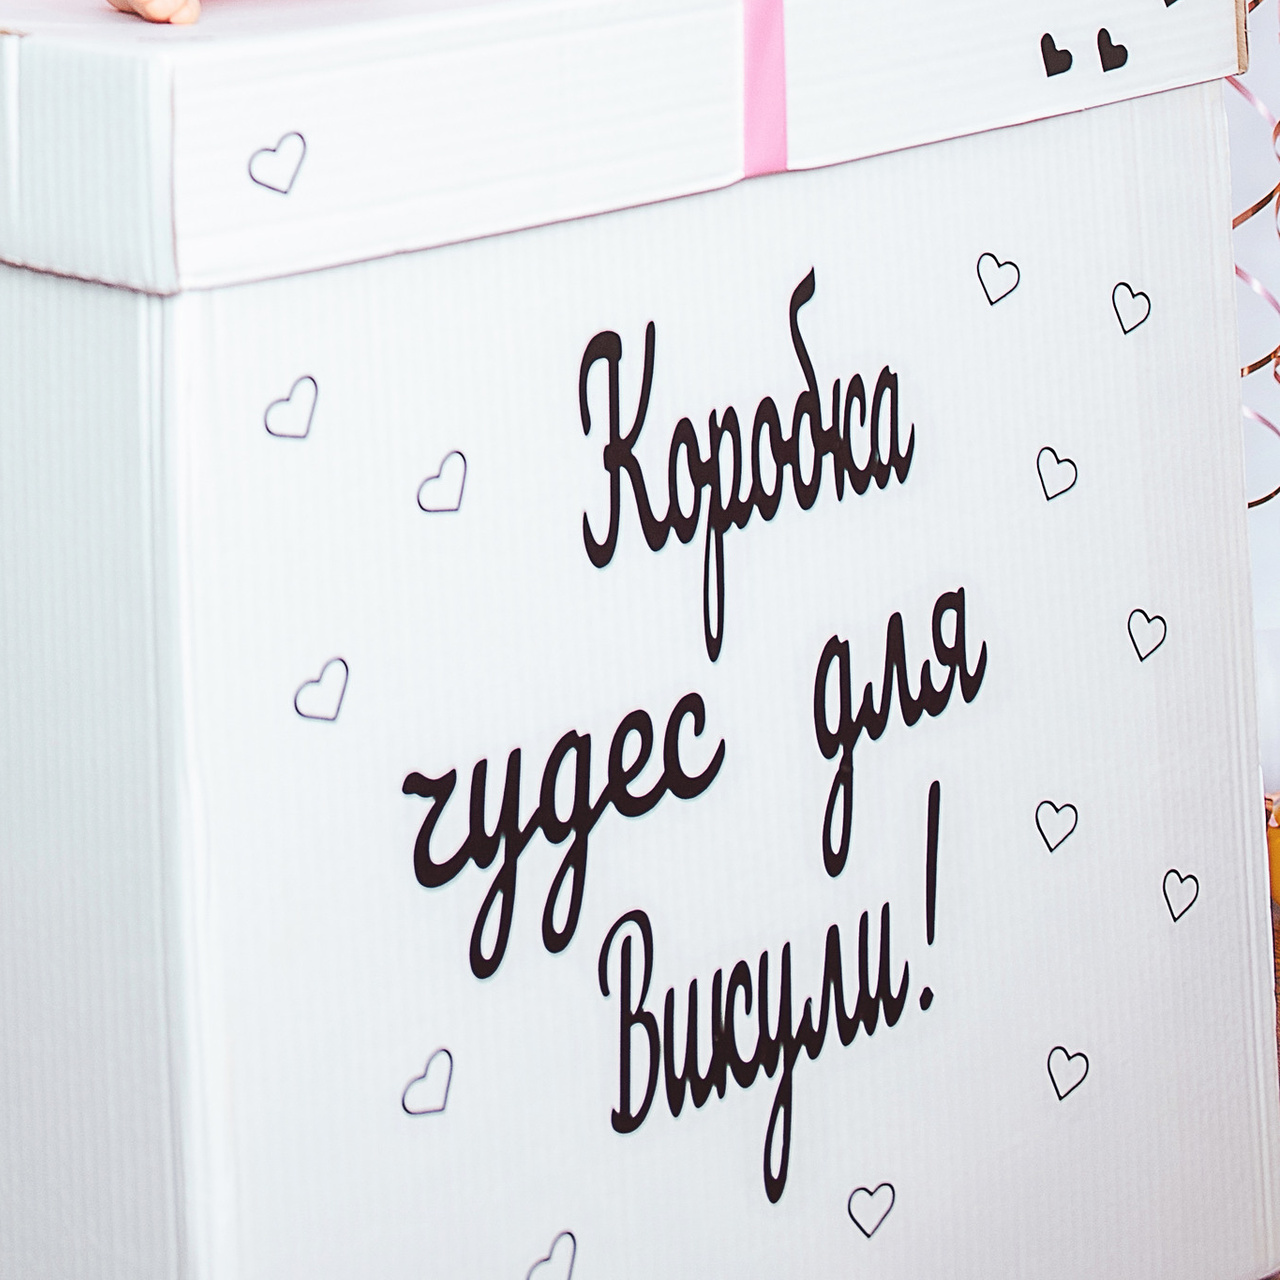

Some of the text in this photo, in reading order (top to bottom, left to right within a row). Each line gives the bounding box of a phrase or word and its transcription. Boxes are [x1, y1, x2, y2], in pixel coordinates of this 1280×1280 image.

[577, 266, 916, 664] Коробка
[400, 586, 988, 981] чудес для
[597, 779, 942, 1205] Викули!
